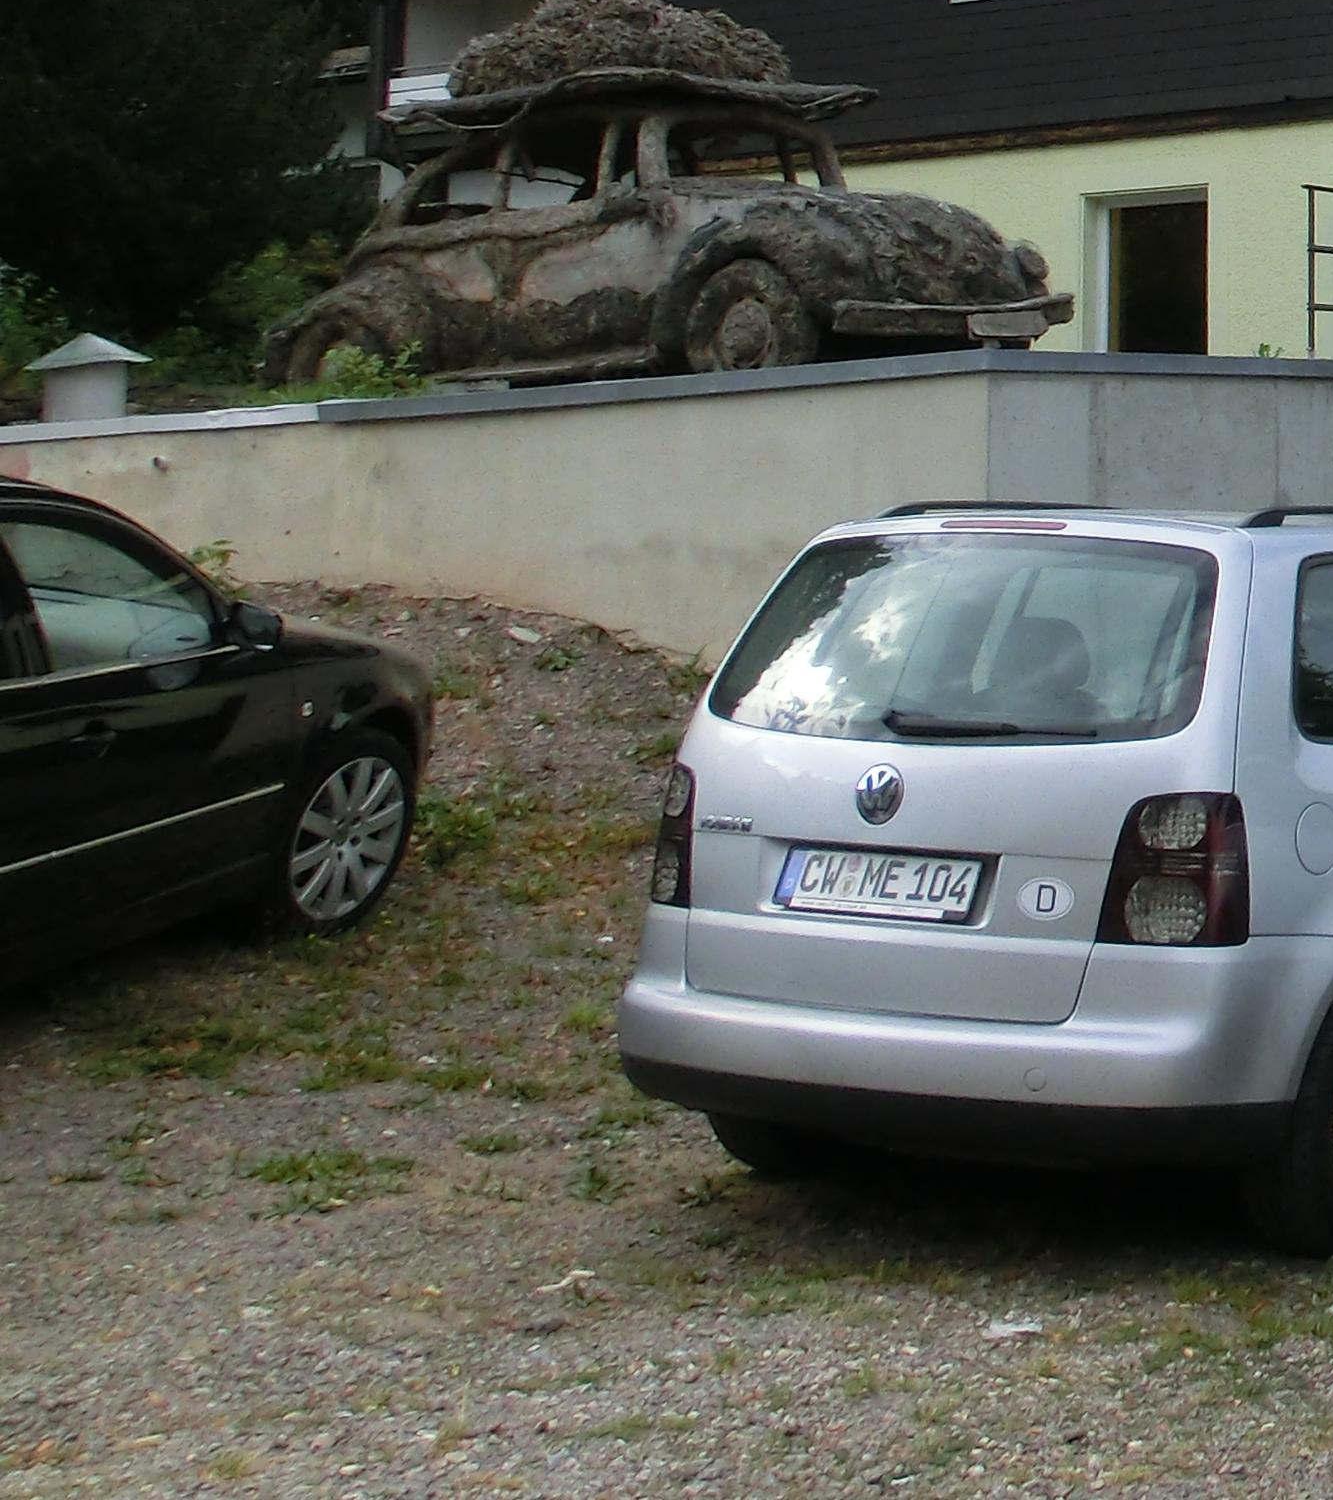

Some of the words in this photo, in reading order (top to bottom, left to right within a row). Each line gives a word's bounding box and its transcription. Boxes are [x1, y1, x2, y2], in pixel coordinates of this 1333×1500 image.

[800, 853, 846, 895] CW
[857, 857, 906, 899] ME
[905, 861, 972, 905] 104
[1036, 884, 1057, 912] D
